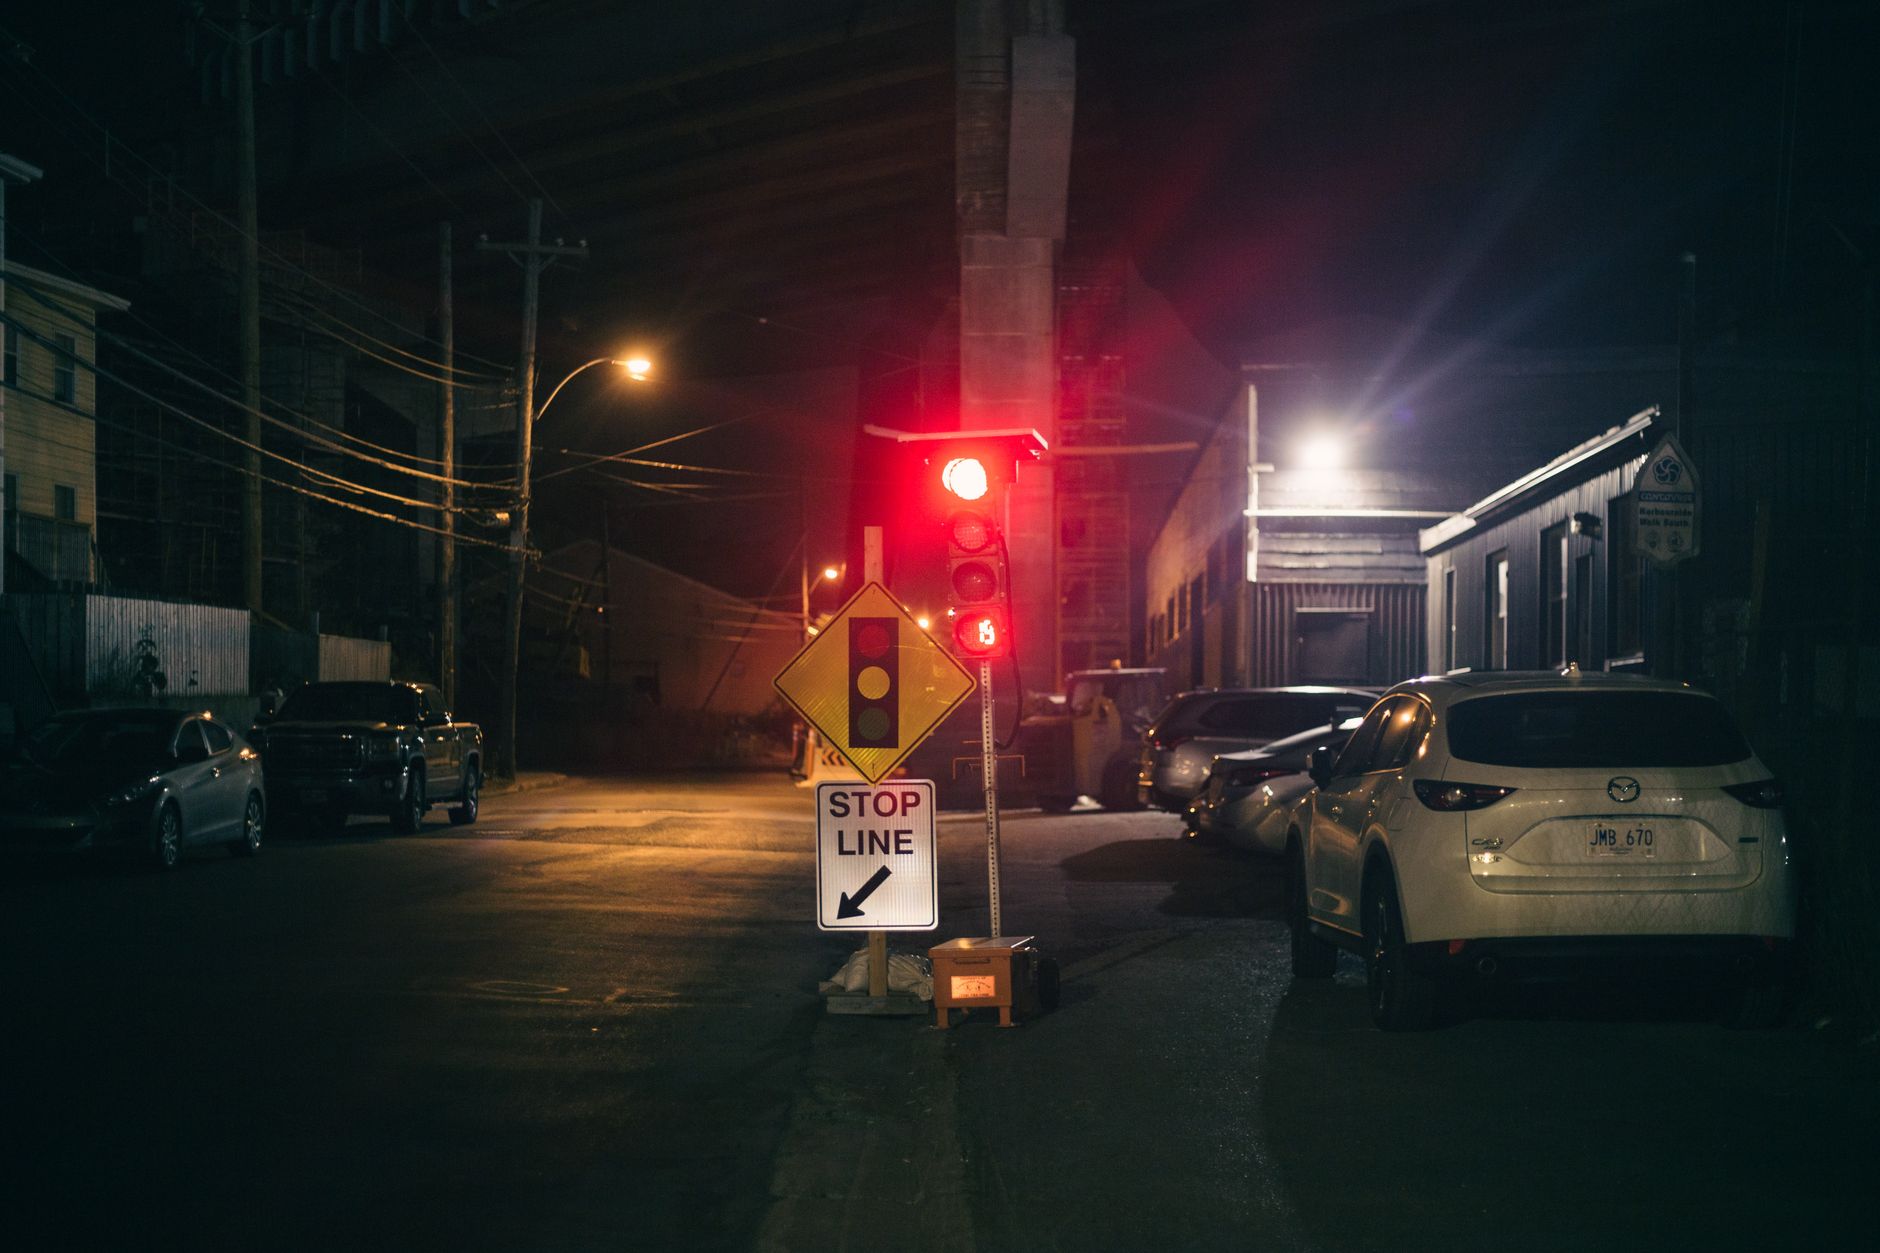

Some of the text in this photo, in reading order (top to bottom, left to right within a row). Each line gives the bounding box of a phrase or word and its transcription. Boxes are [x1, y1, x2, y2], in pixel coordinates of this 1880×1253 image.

[829, 791, 921, 818] STOP
[837, 829, 914, 856] LINE
[1590, 829, 1653, 846] JMB 670
